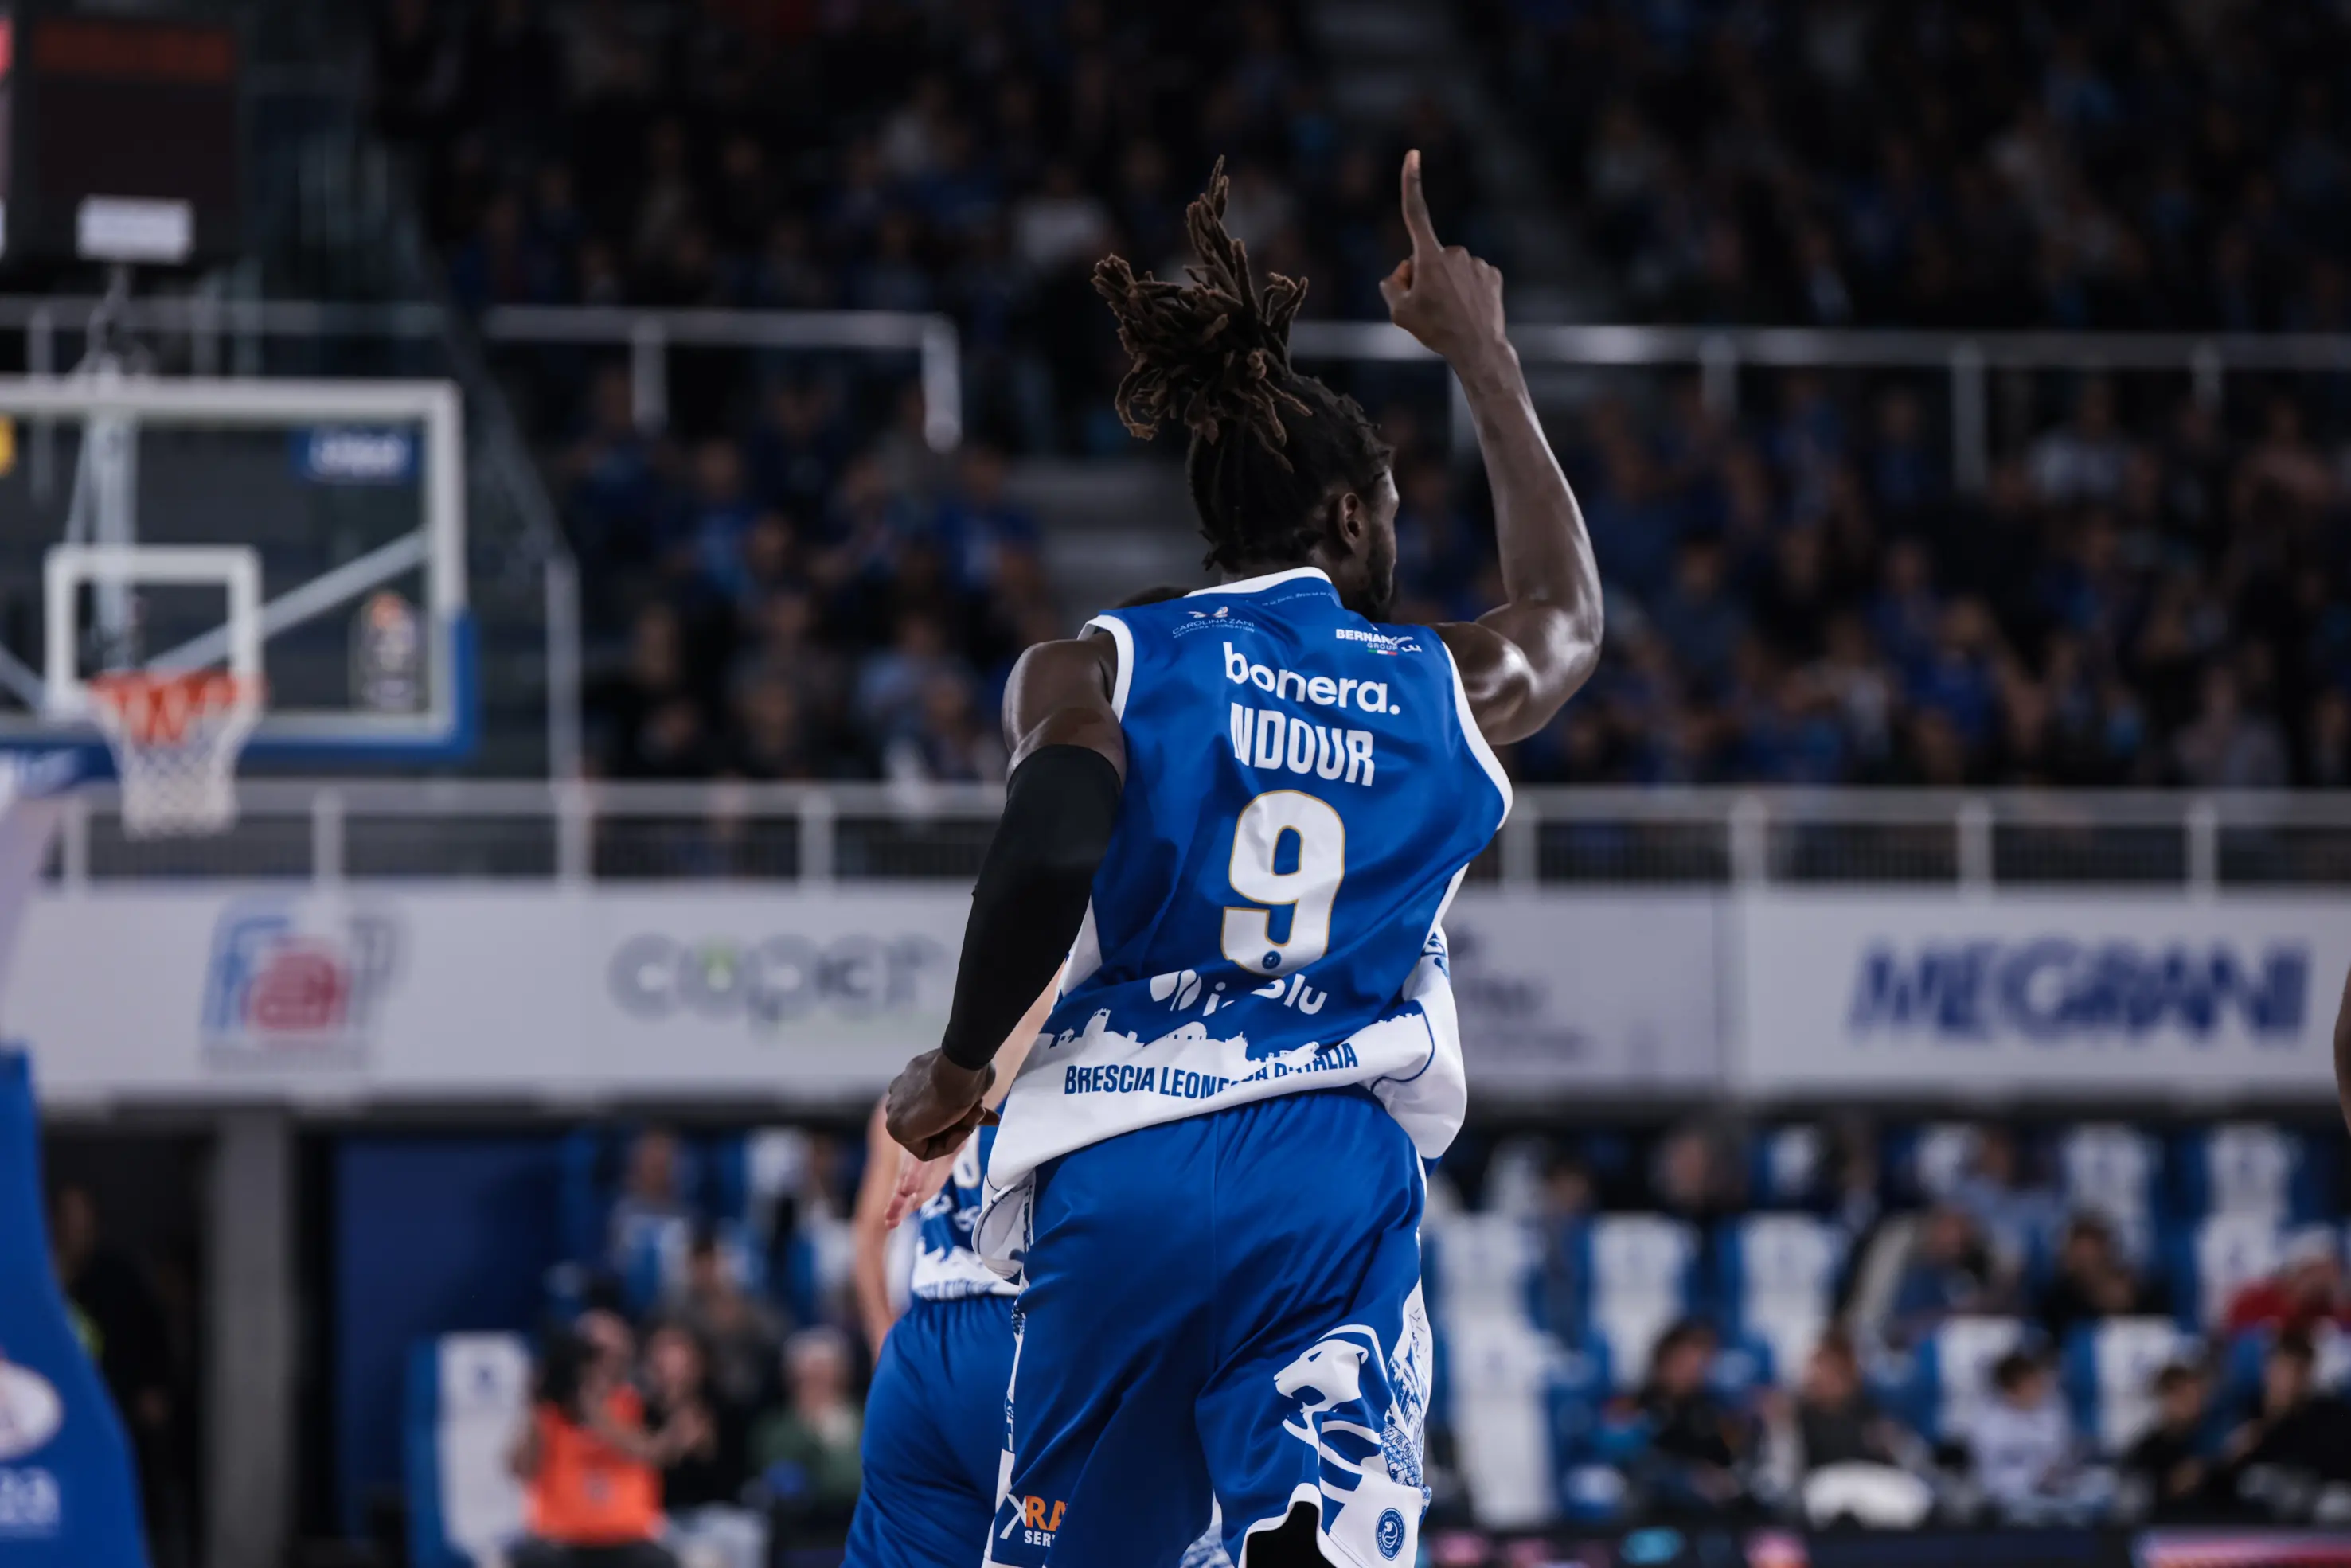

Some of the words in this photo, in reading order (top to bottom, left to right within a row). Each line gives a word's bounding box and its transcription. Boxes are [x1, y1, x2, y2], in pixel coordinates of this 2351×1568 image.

[1223, 642, 1401, 715] bonera.
[1367, 642, 1398, 651] GROUP
[1230, 702, 1375, 786] NDOUR
[1220, 789, 1345, 977] 9
[1064, 1064, 1154, 1094] BRESCIA
